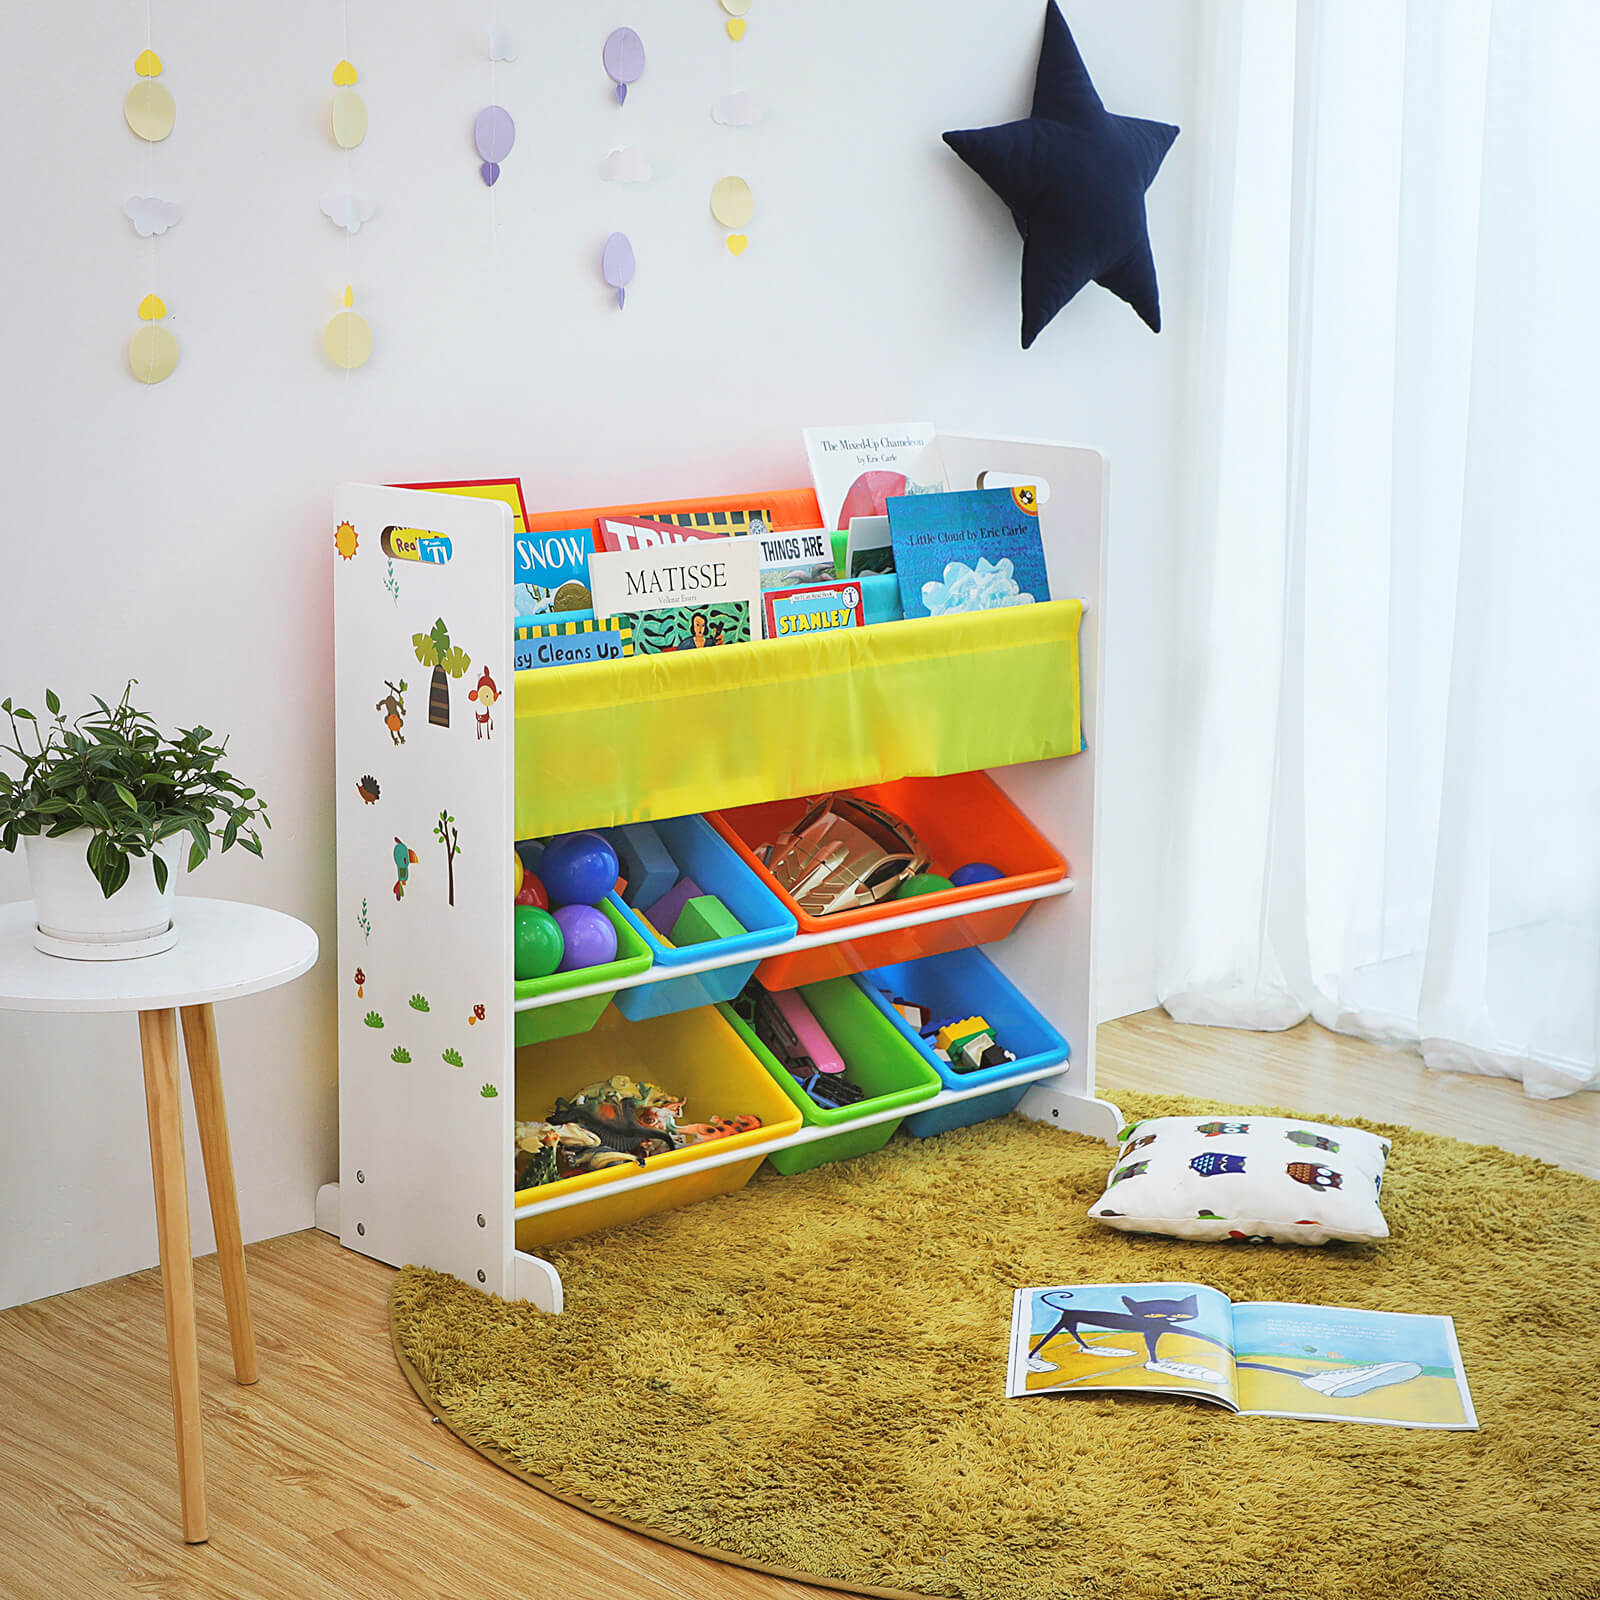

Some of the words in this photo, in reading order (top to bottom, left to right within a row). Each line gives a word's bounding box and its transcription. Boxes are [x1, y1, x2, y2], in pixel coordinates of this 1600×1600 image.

[820, 440, 838, 451] The
[880, 436, 924, 448] Chameleon
[857, 455, 865, 465] by
[760, 538, 801, 562] THINGS
[802, 535, 825, 557] ARE
[909, 533, 935, 546] Little
[938, 530, 965, 543] Cloud
[967, 530, 978, 543] by
[980, 527, 1001, 539] Eric
[1002, 524, 1028, 537] Carle
[516, 536, 585, 570] SNOW
[625, 563, 728, 596] MATISSE
[779, 608, 852, 635] STANLEY
[513, 652, 533, 669] sy
[537, 642, 592, 663] Cleans
[597, 642, 620, 659] Up
